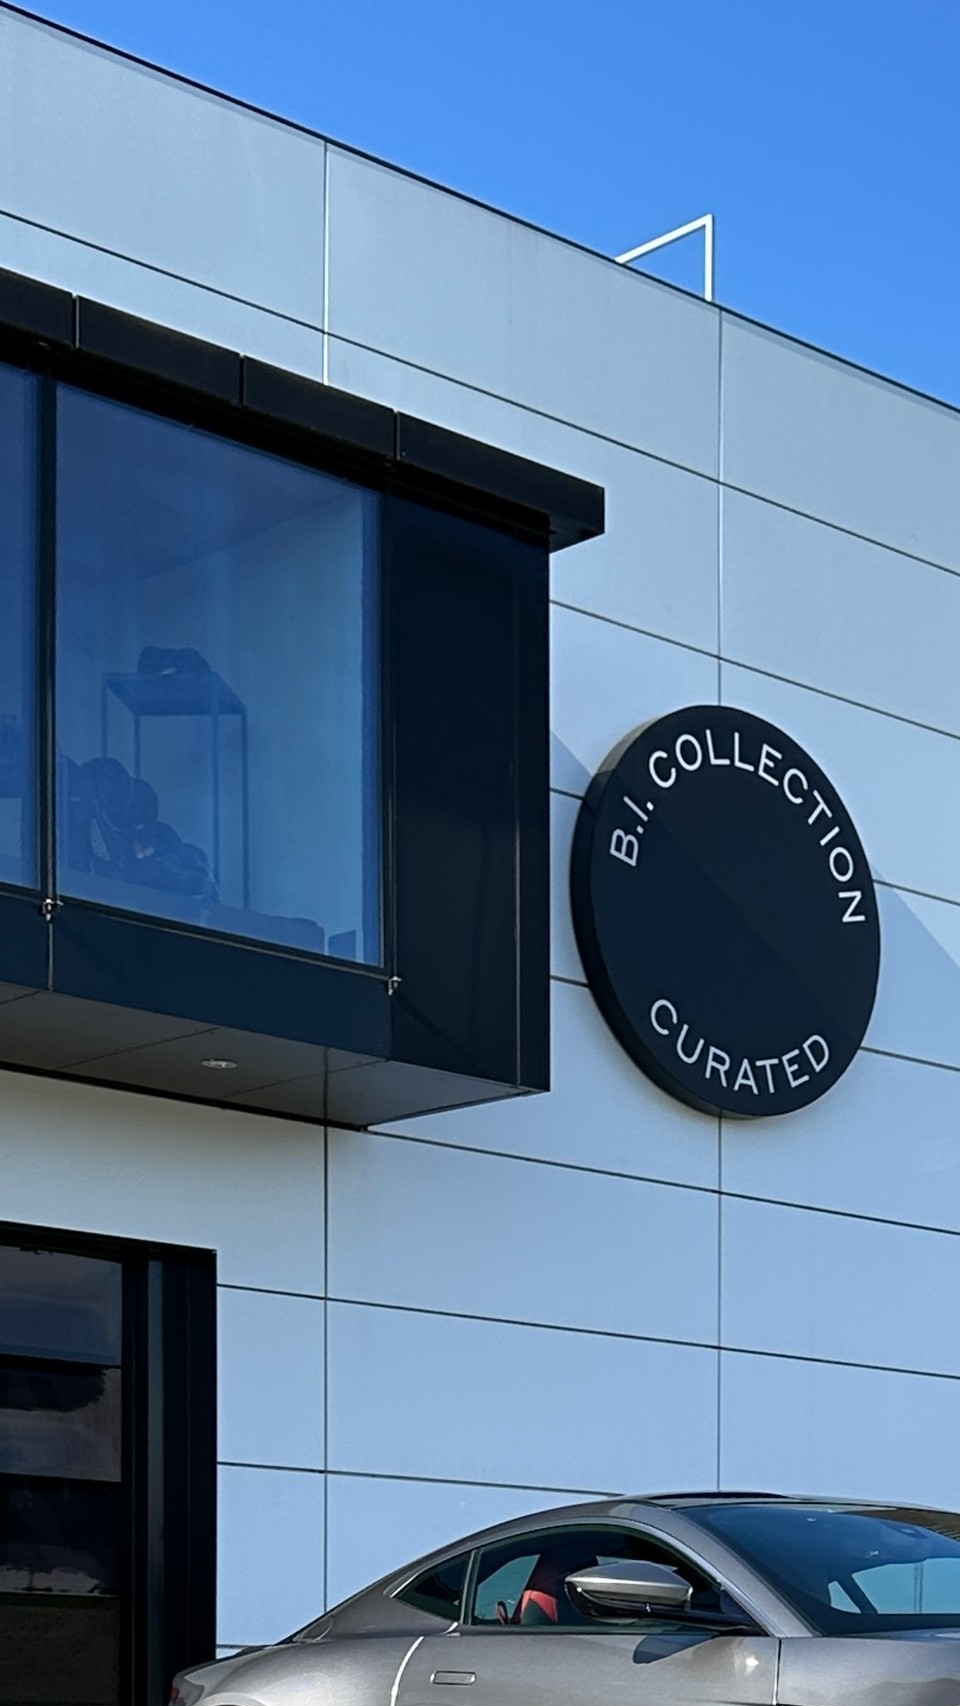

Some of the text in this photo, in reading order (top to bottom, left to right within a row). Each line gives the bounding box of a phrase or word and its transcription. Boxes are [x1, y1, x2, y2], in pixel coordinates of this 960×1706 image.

[609, 729, 867, 923] B.I. COLLECTION
[650, 999, 831, 1095] CURATED
